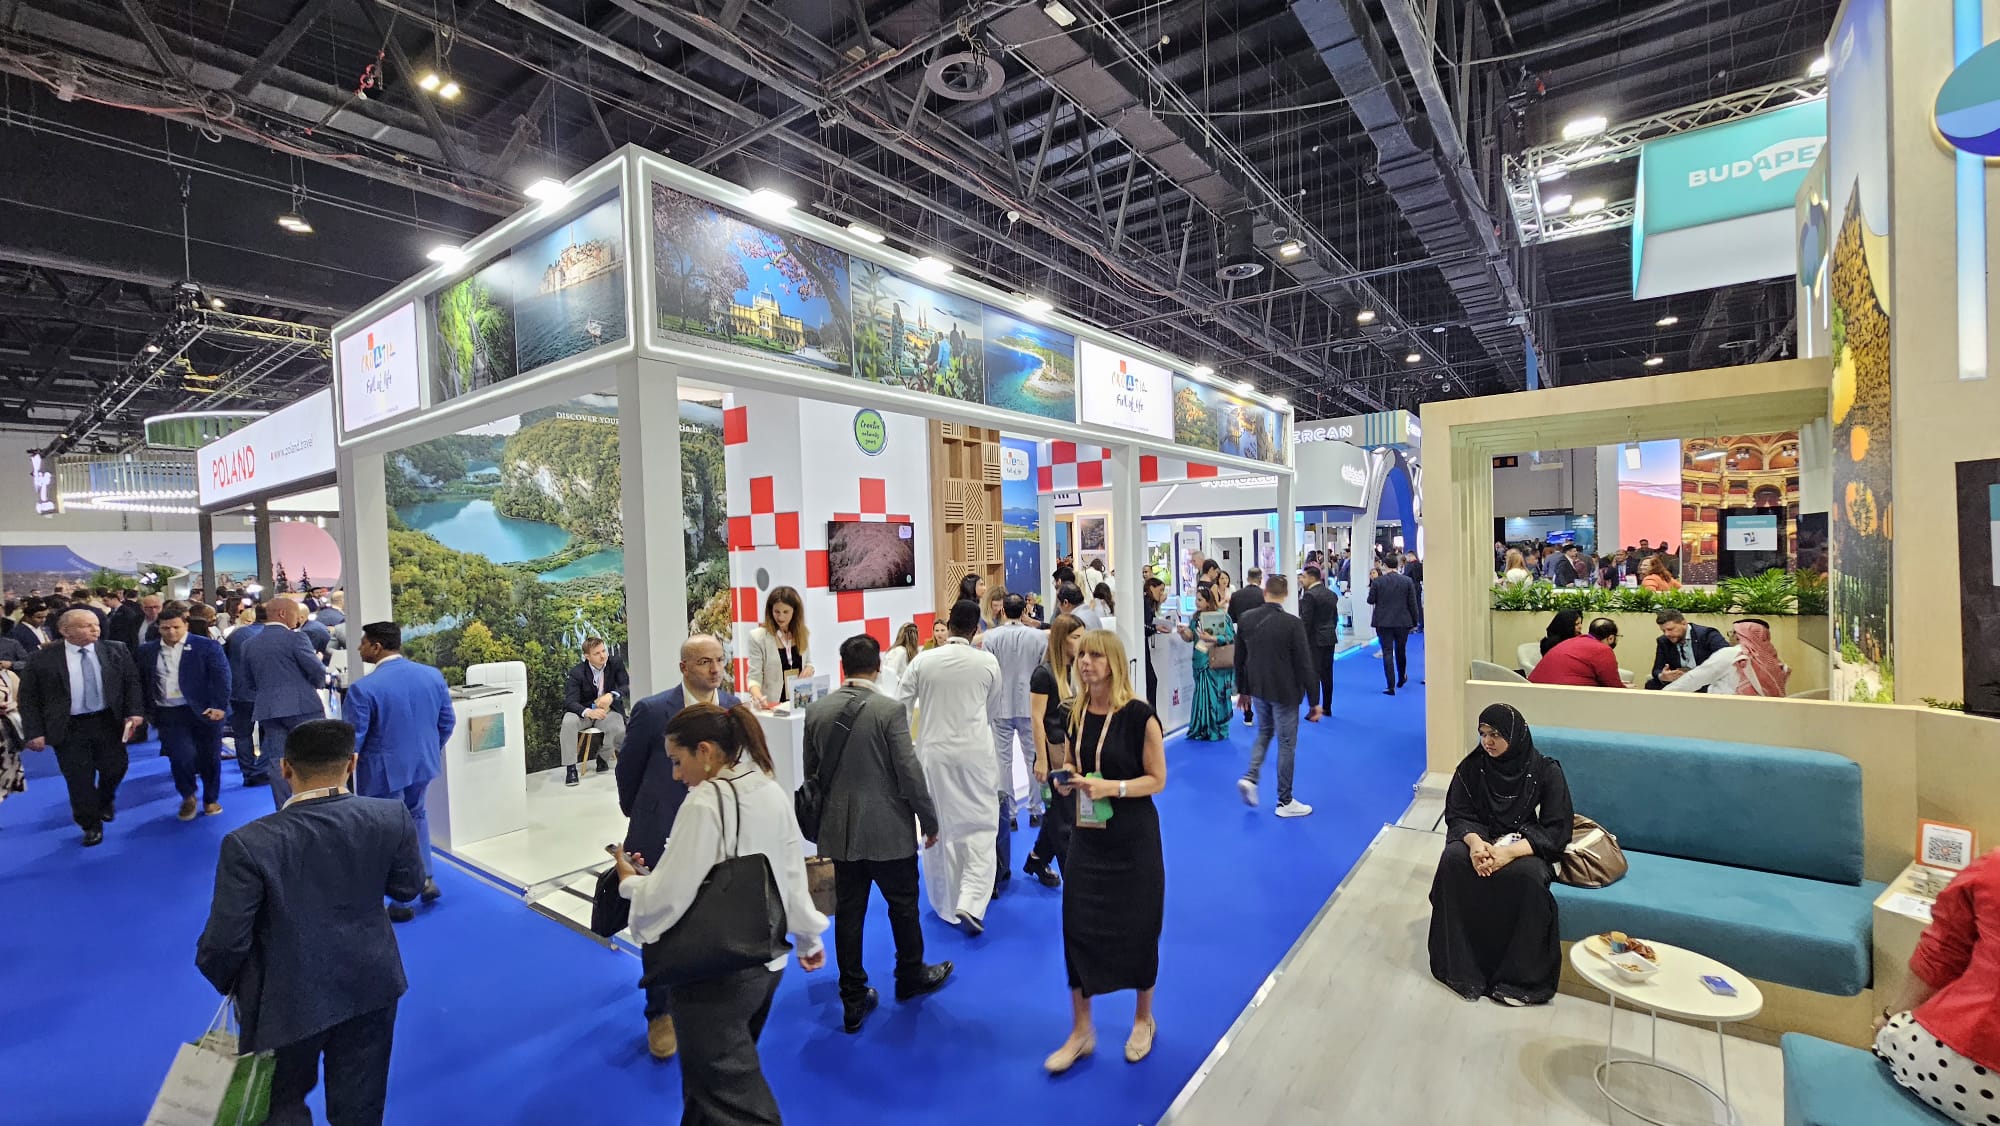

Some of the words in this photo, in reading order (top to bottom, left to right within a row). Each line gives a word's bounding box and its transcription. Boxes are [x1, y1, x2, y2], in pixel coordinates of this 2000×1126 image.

[1688, 142, 1821, 188] BUDAPE
[556, 411, 597, 424] DISCOVER
[212, 444, 255, 490] POLAND
